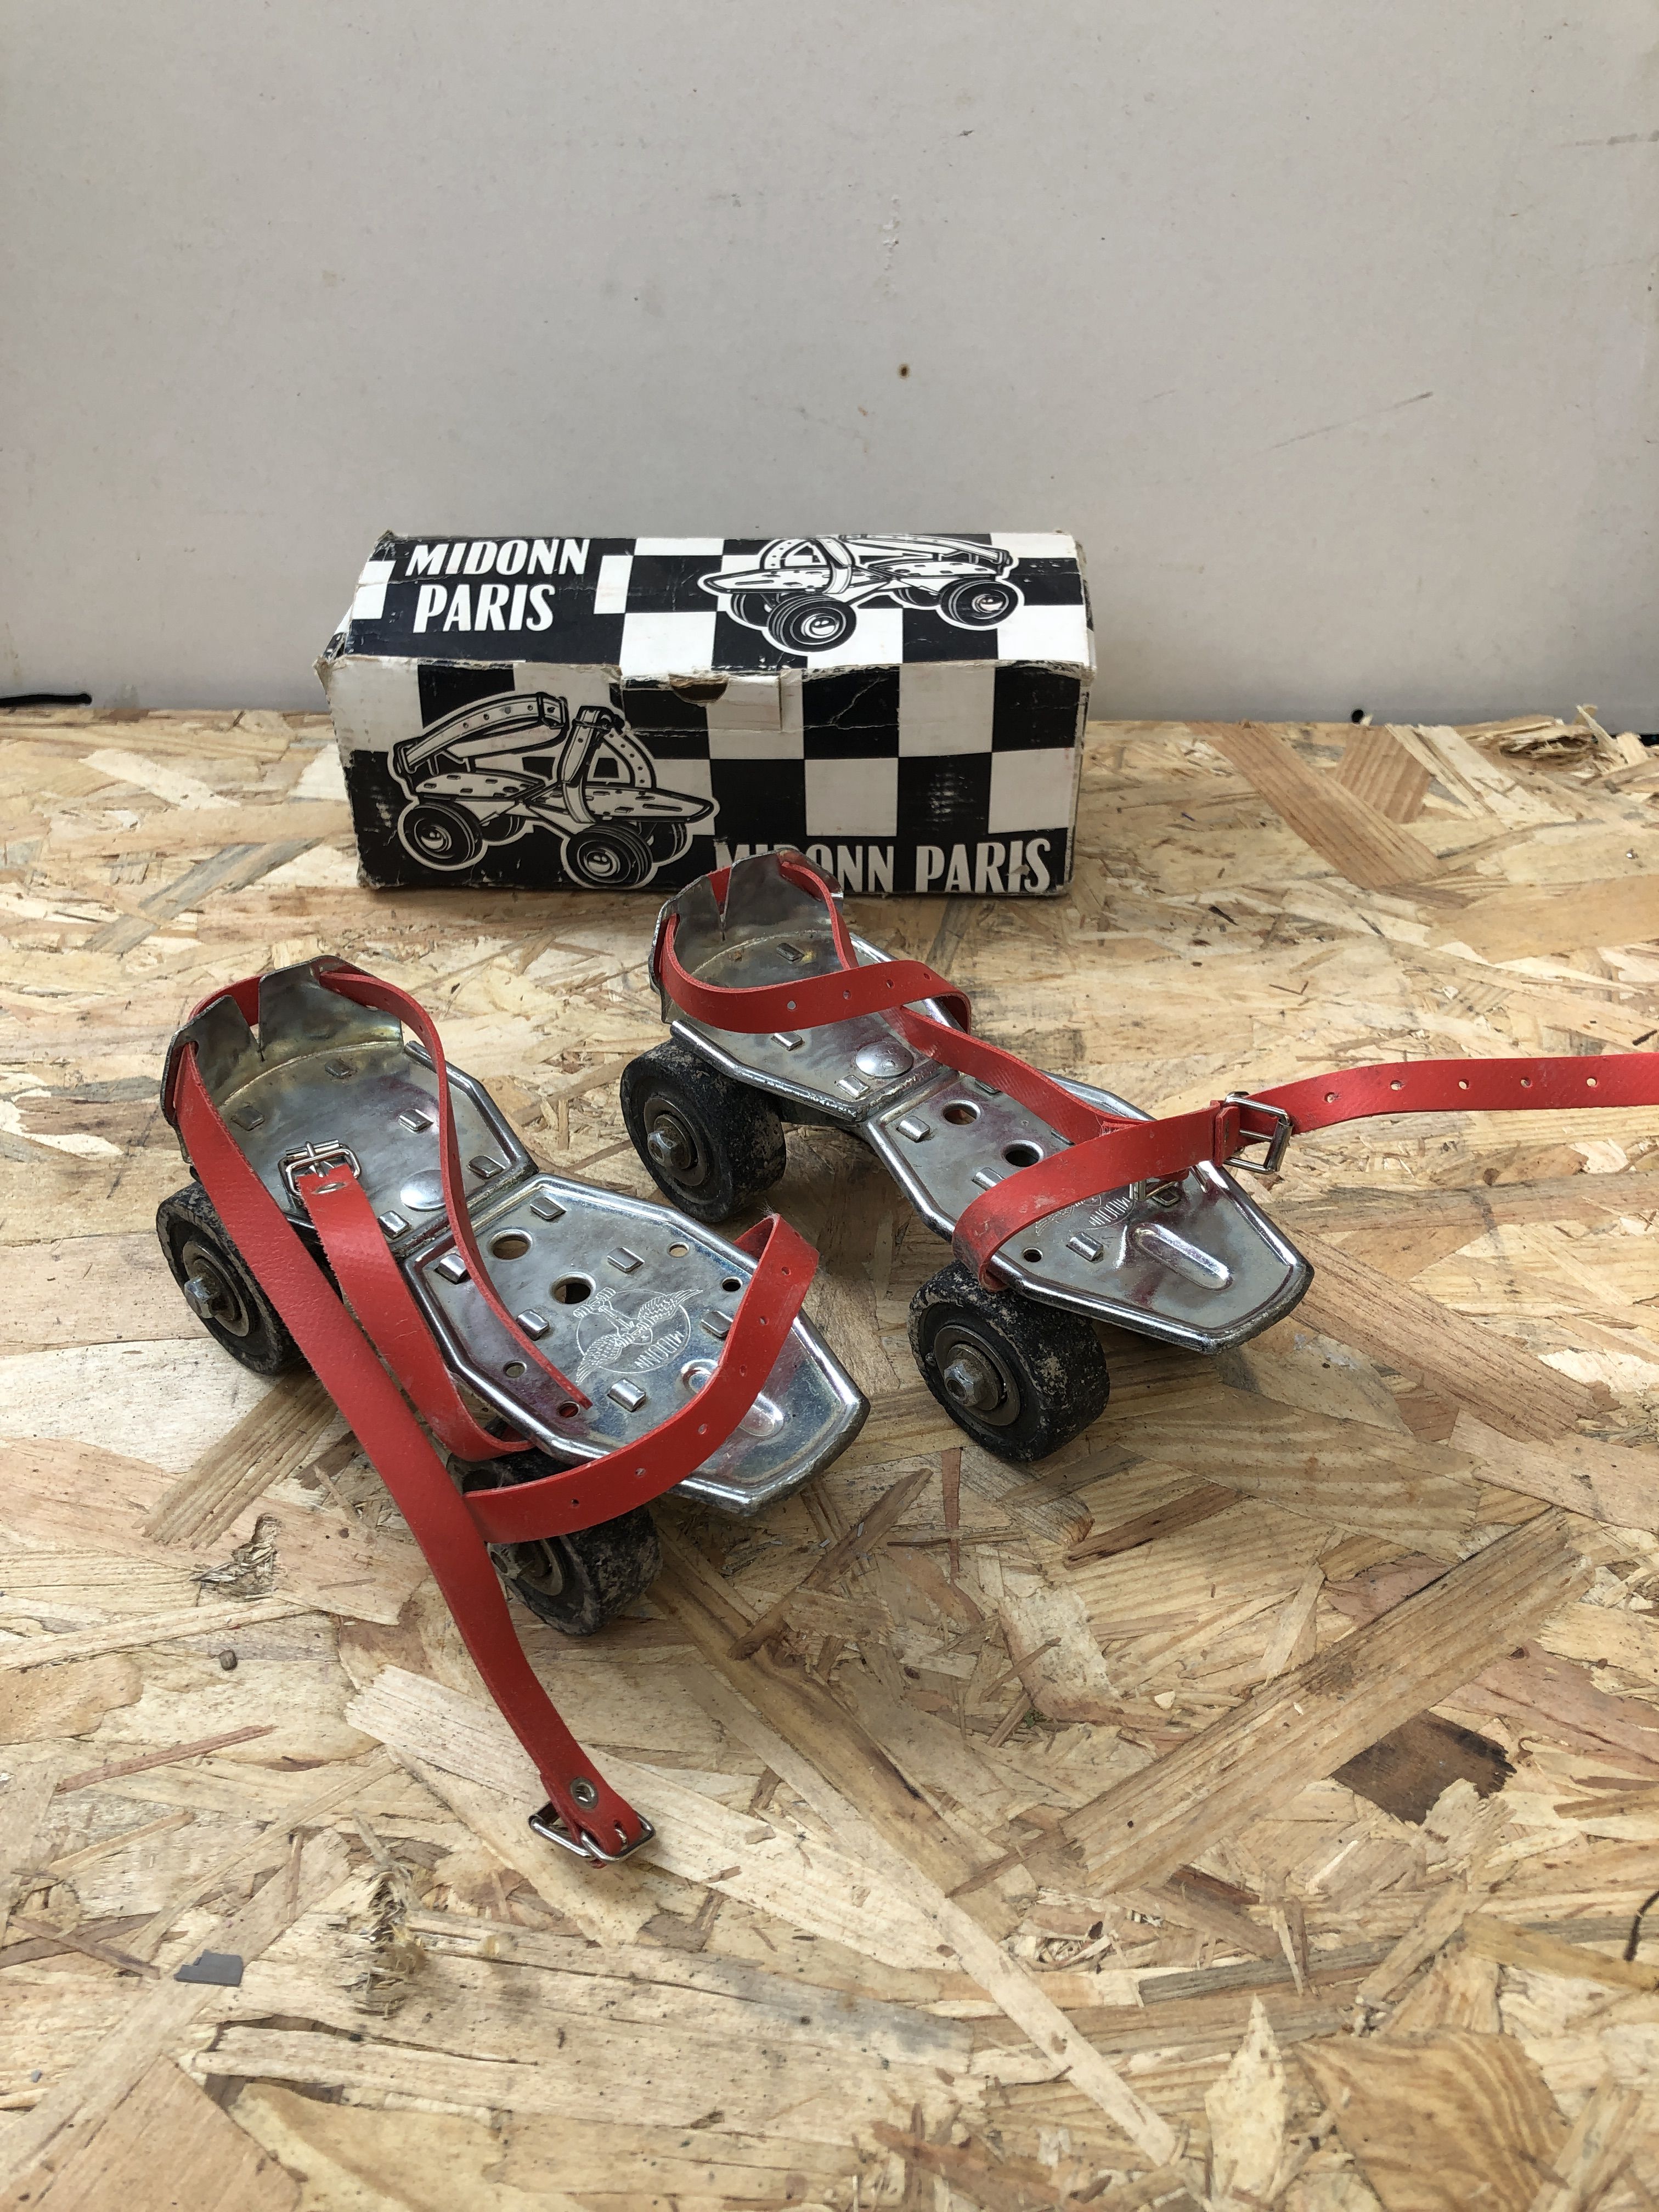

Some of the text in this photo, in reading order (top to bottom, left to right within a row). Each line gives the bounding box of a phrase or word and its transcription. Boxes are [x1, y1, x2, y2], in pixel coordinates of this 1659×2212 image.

[405, 538, 591, 577] MIDONN
[413, 583, 555, 633] PARIS
[916, 838, 1051, 893] PARIS
[634, 1330, 685, 1369] MIDONN
